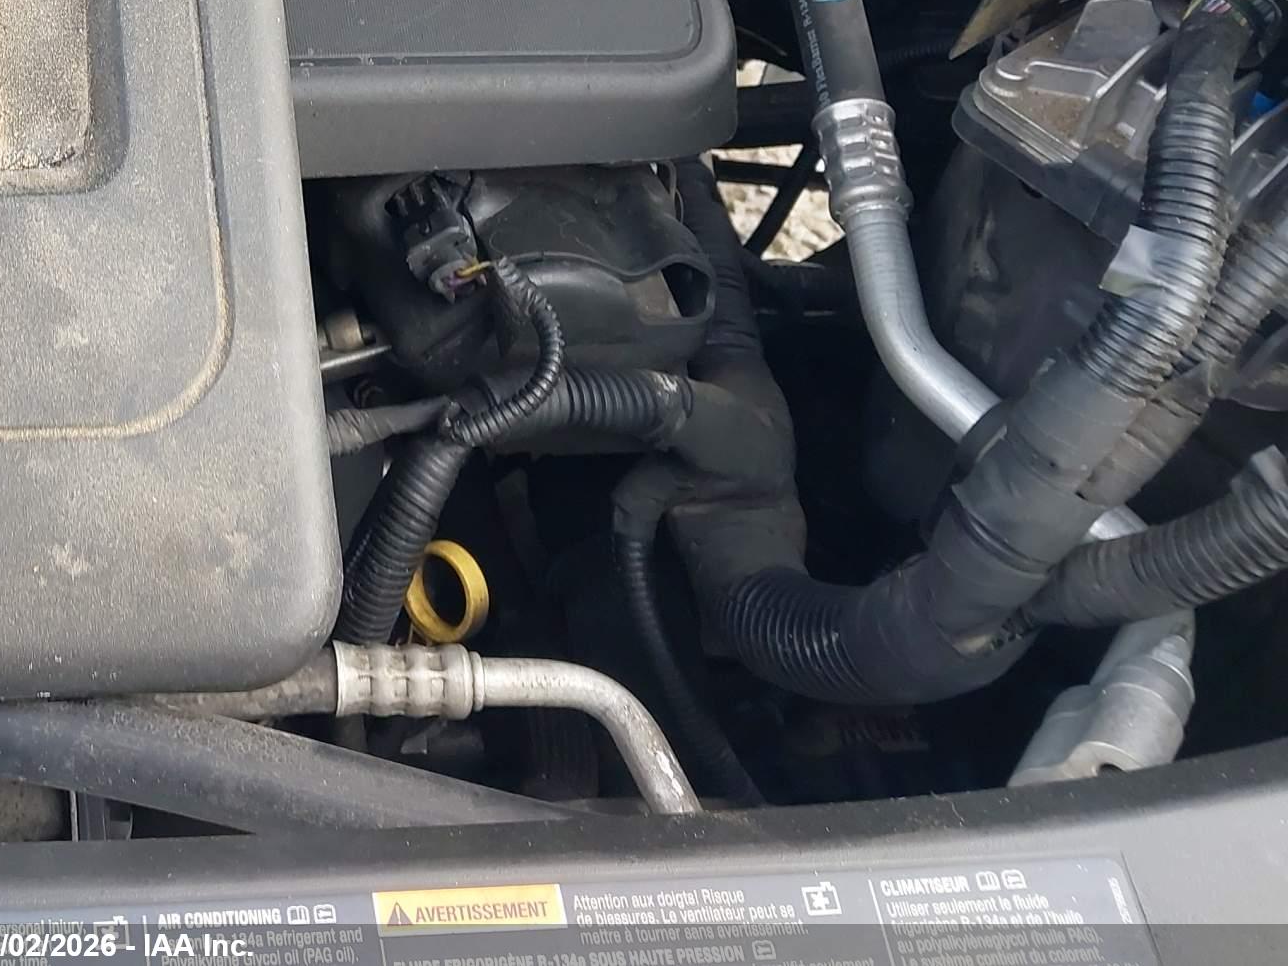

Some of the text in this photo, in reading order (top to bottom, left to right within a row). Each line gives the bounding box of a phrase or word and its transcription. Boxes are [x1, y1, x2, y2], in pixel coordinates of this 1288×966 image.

[880, 876, 971, 896] CLIMATISEUR
[573, 895, 626, 911] Attention
[630, 893, 655, 909] aux
[701, 888, 745, 909] Risque
[886, 894, 1049, 918] Utiliser seulement le fluide
[158, 908, 282, 930] AIR CONDITIONING
[415, 901, 549, 923] AVERTISSEMENT
[576, 904, 796, 928] de blessures. Le ventilateur peut se
[1026, 913, 1043, 928] de
[266, 926, 337, 948] Refrigerant
[339, 926, 364, 944] and
[580, 927, 621, 945] mettre
[635, 927, 682, 943] tourner
[684, 925, 714, 941] sans
[716, 920, 809, 939] avertissement.
[284, 948, 300, 966] oil
[303, 946, 332, 966] (PAG
[335, 945, 360, 965] oil).
[588, 950, 627, 966] SOUS
[628, 947, 675, 966] HAUTE
[676, 945, 745, 965] PRESSION
[897, 940, 915, 954] au
